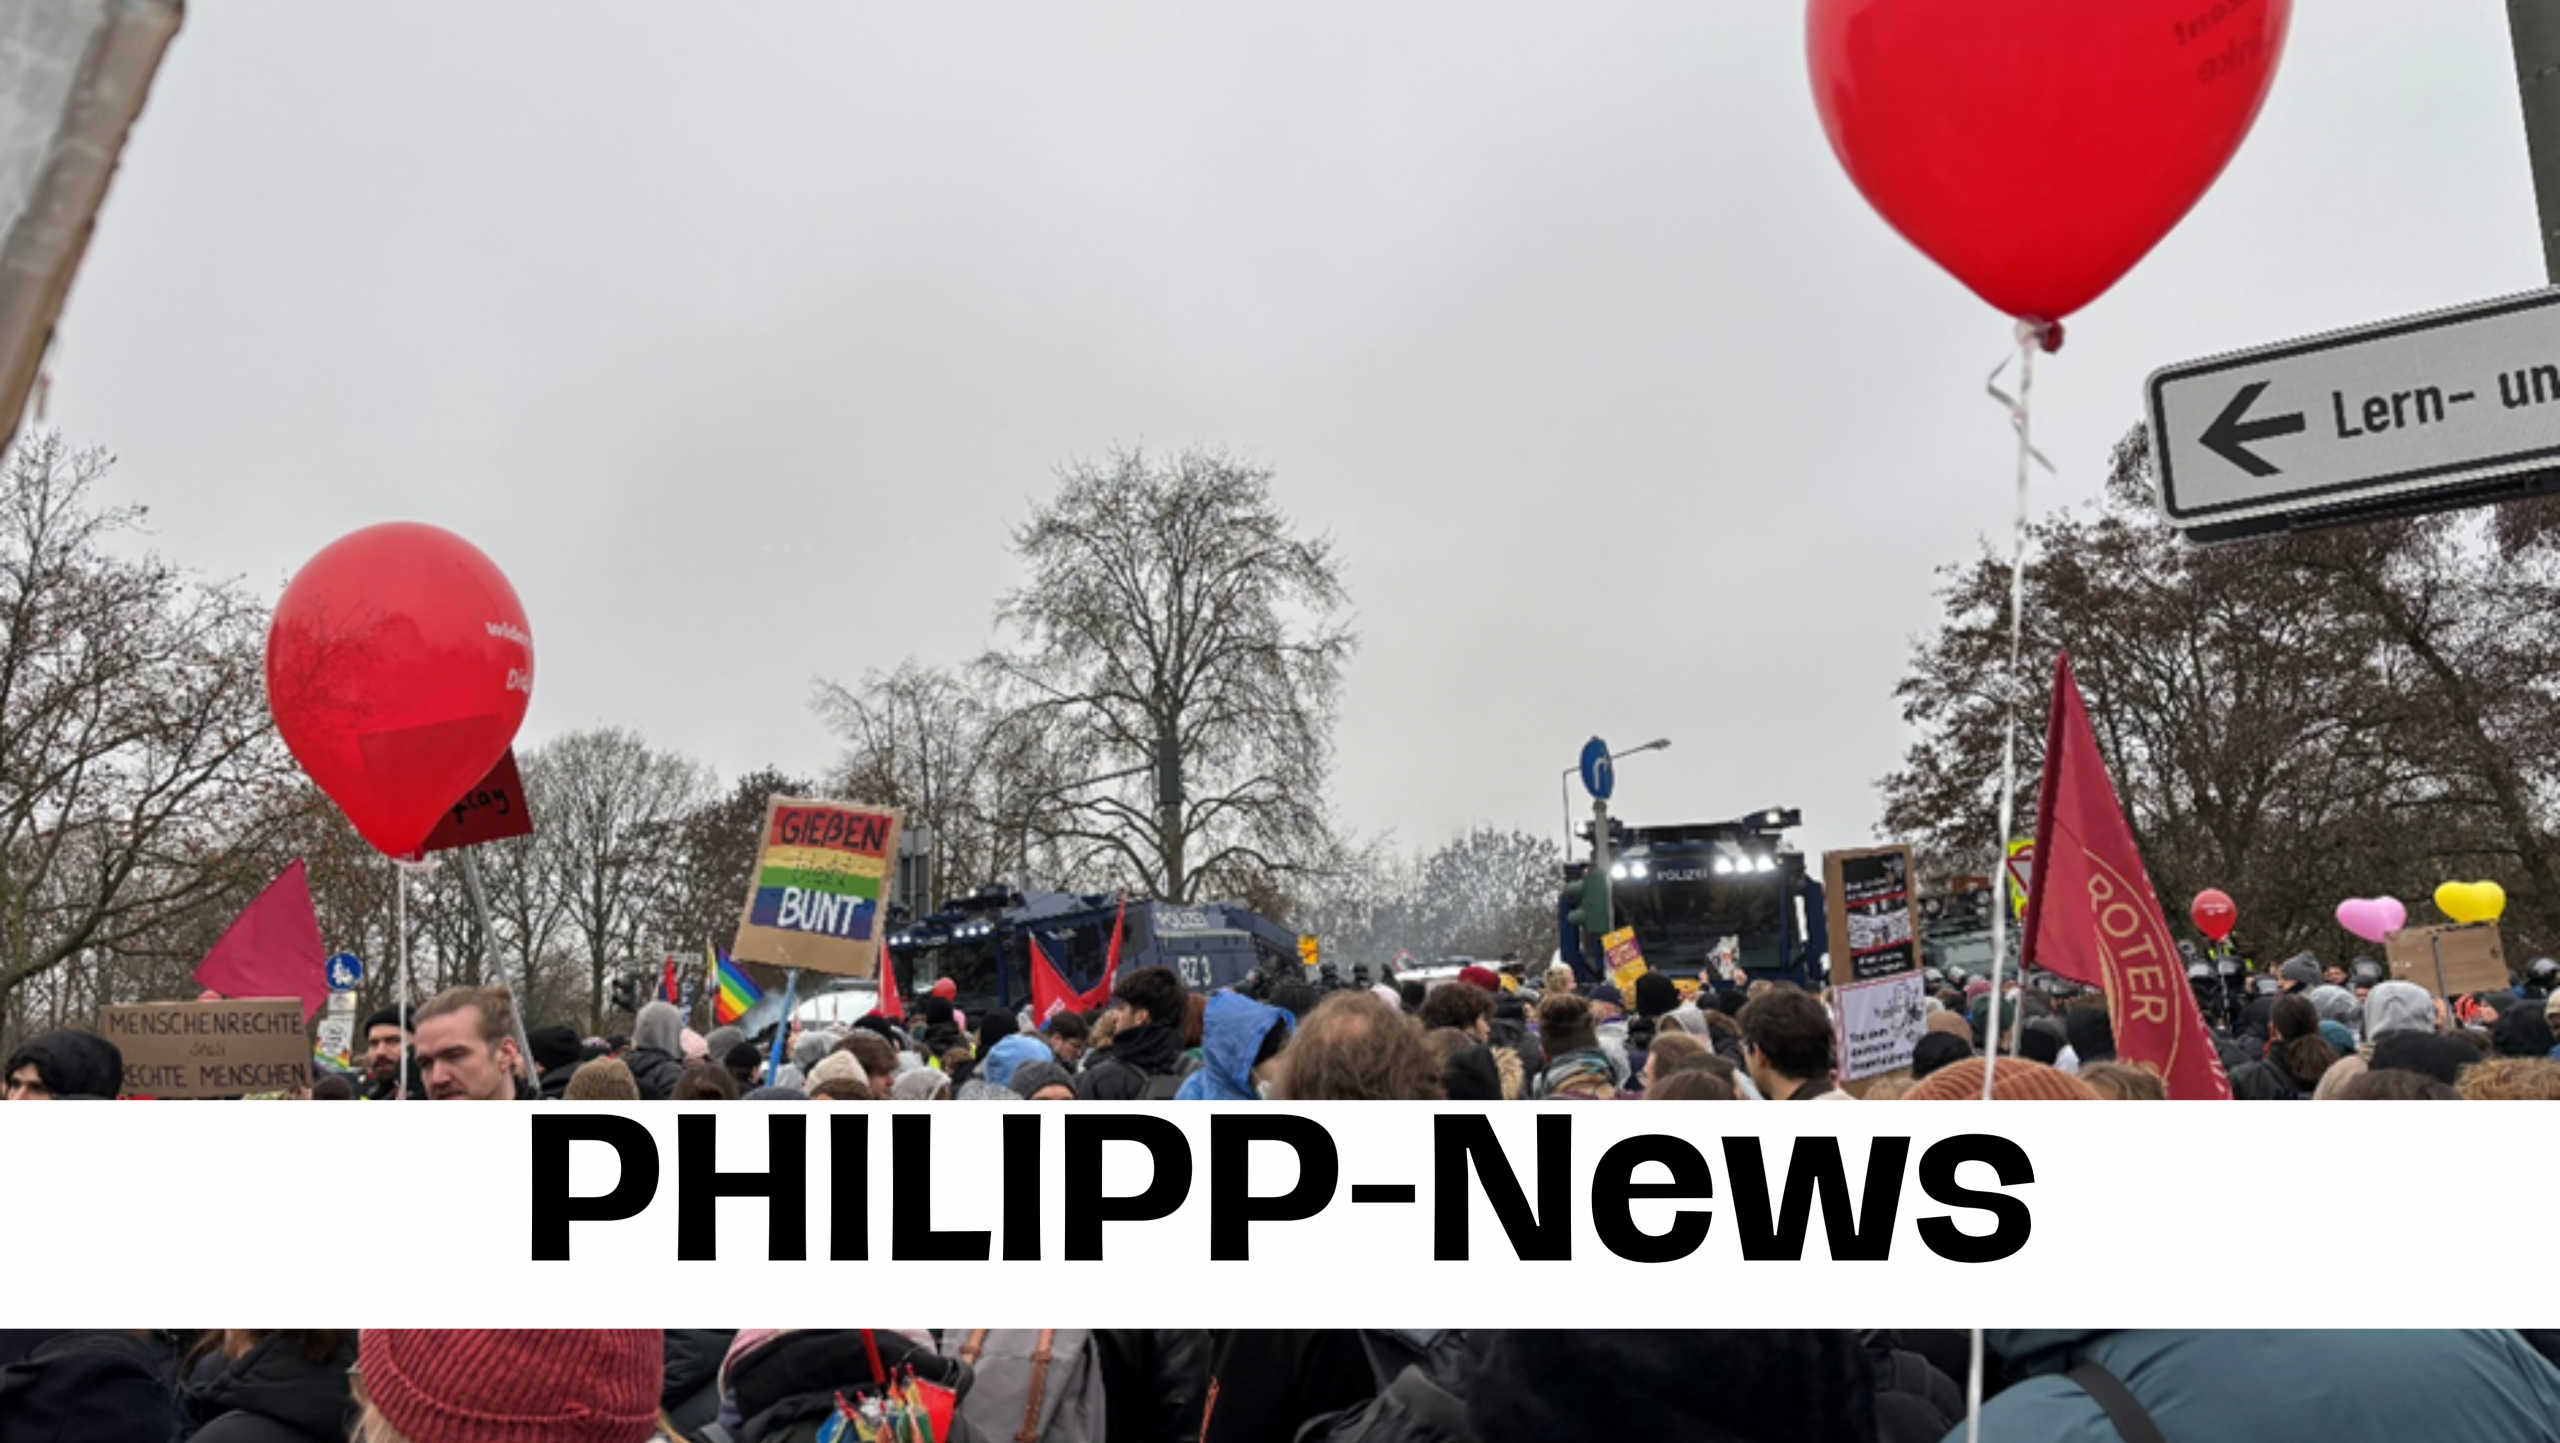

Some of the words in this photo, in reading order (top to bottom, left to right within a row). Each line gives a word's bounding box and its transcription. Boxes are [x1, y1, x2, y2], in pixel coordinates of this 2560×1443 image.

[2331, 385, 2475, 439] Lern-
[1656, 868, 1708, 881] POLIZEI
[777, 886, 864, 935] BUNT
[2087, 873, 2168, 1024] ROTER
[109, 1012, 304, 1036] MENSCHENRECHTE
[199, 1063, 308, 1088] MENSCHEN
